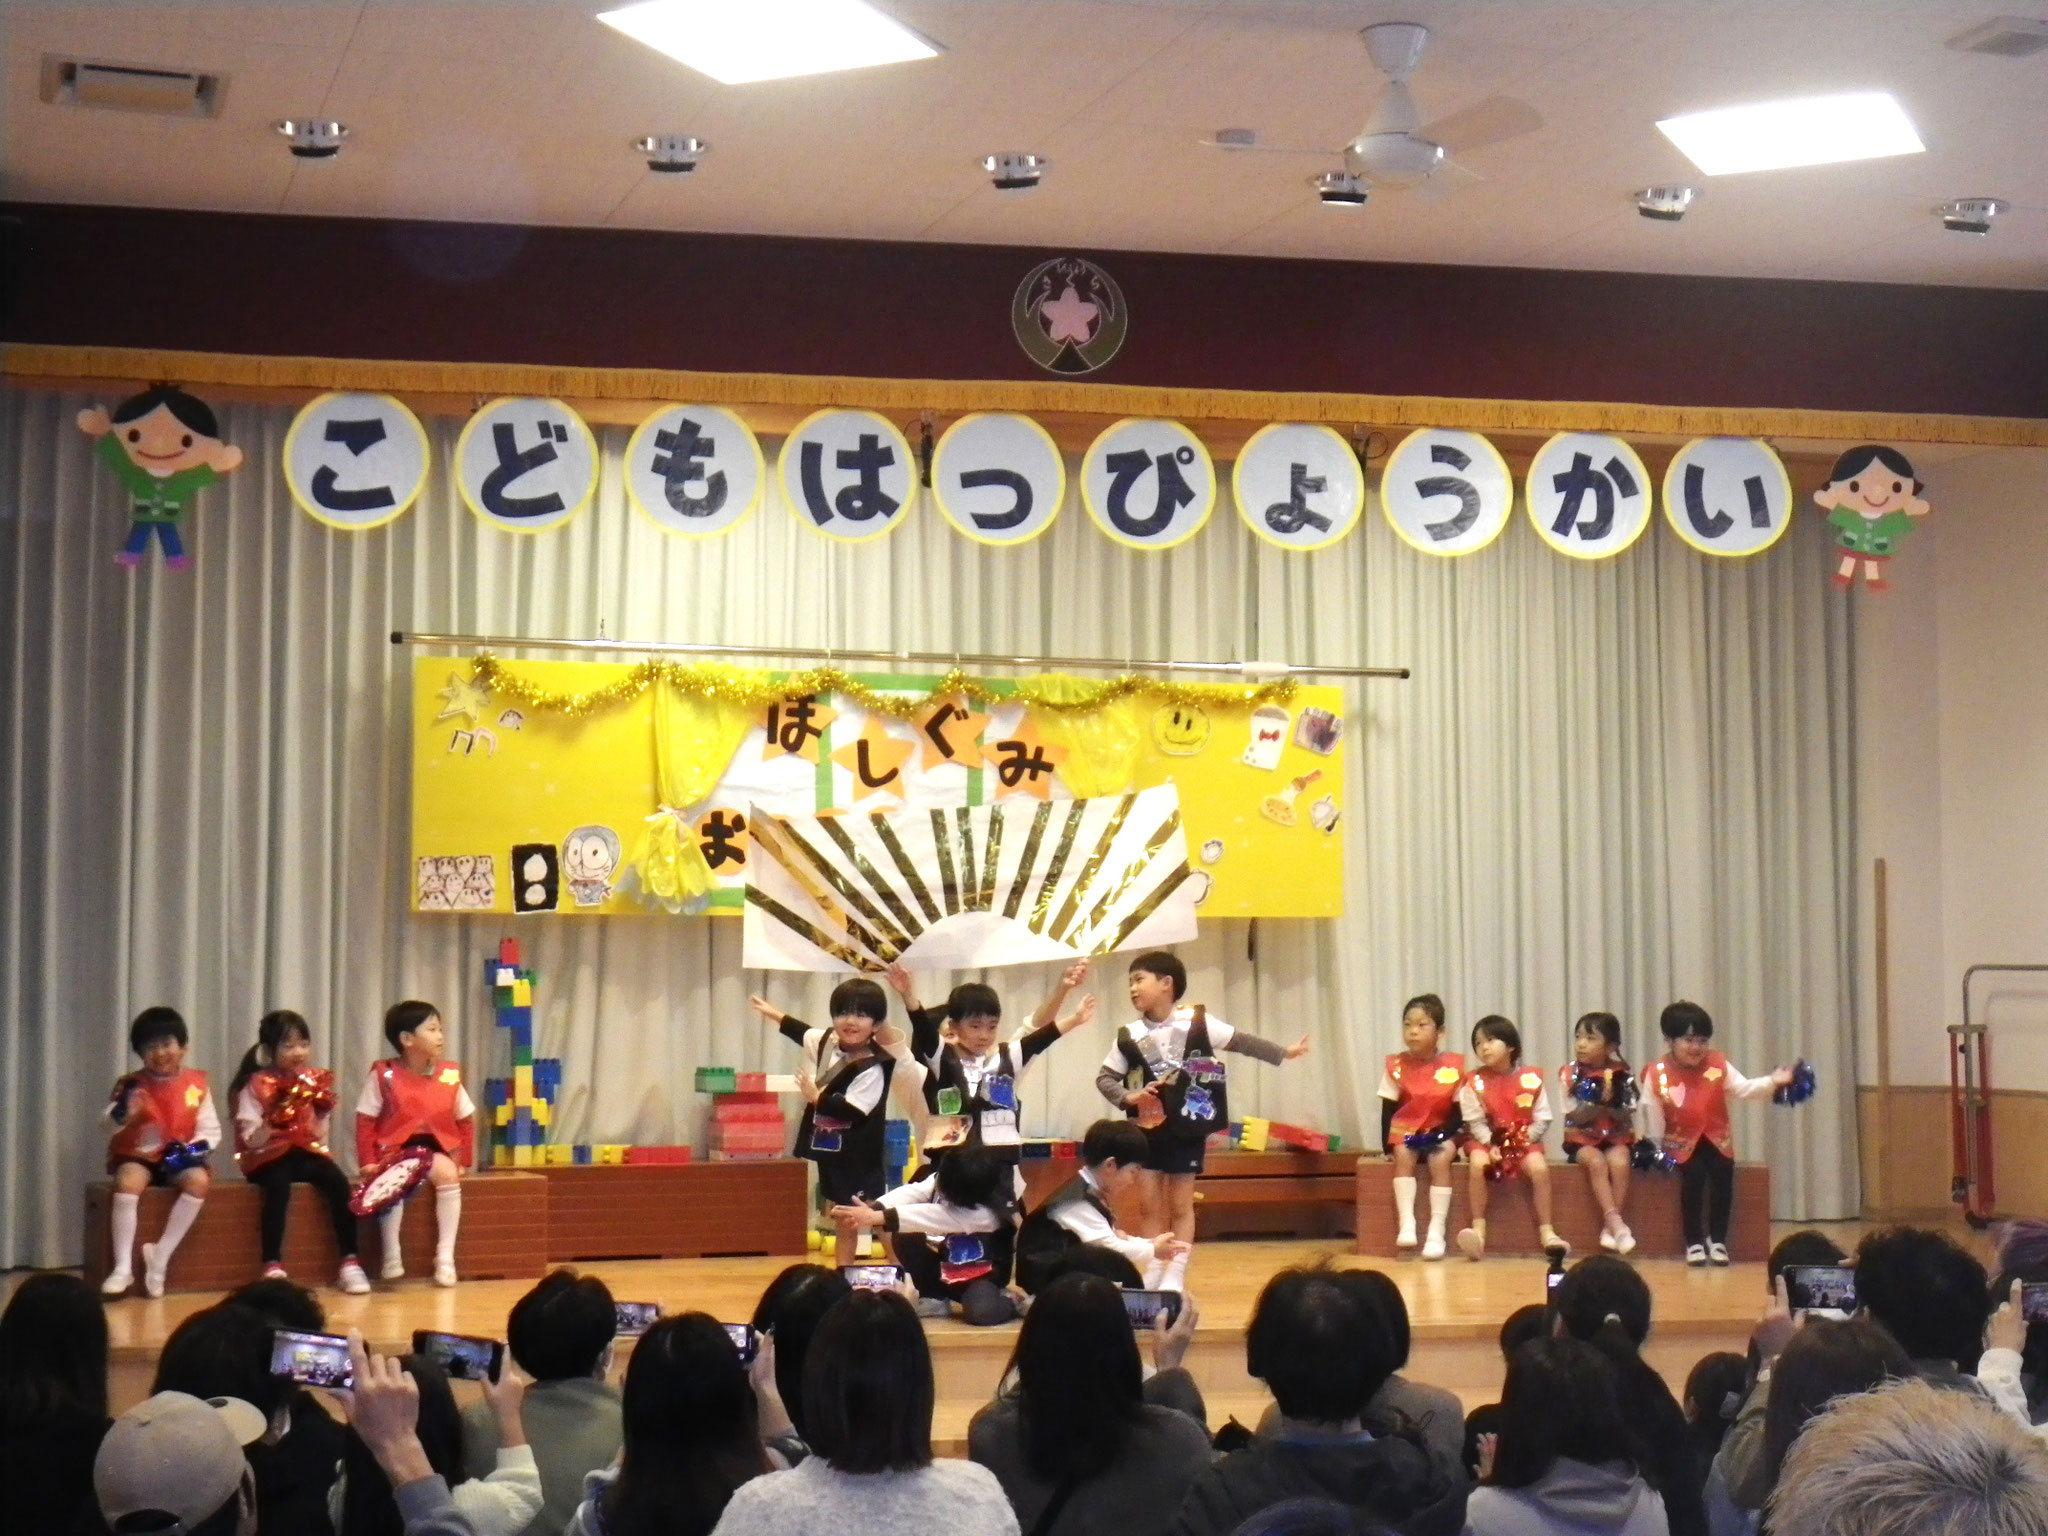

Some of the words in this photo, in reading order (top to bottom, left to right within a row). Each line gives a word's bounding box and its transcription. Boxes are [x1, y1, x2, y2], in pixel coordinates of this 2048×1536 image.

[311, 417, 1772, 542] こどもはっぴょうかい
[766, 693, 1055, 788] ほしぐみ
